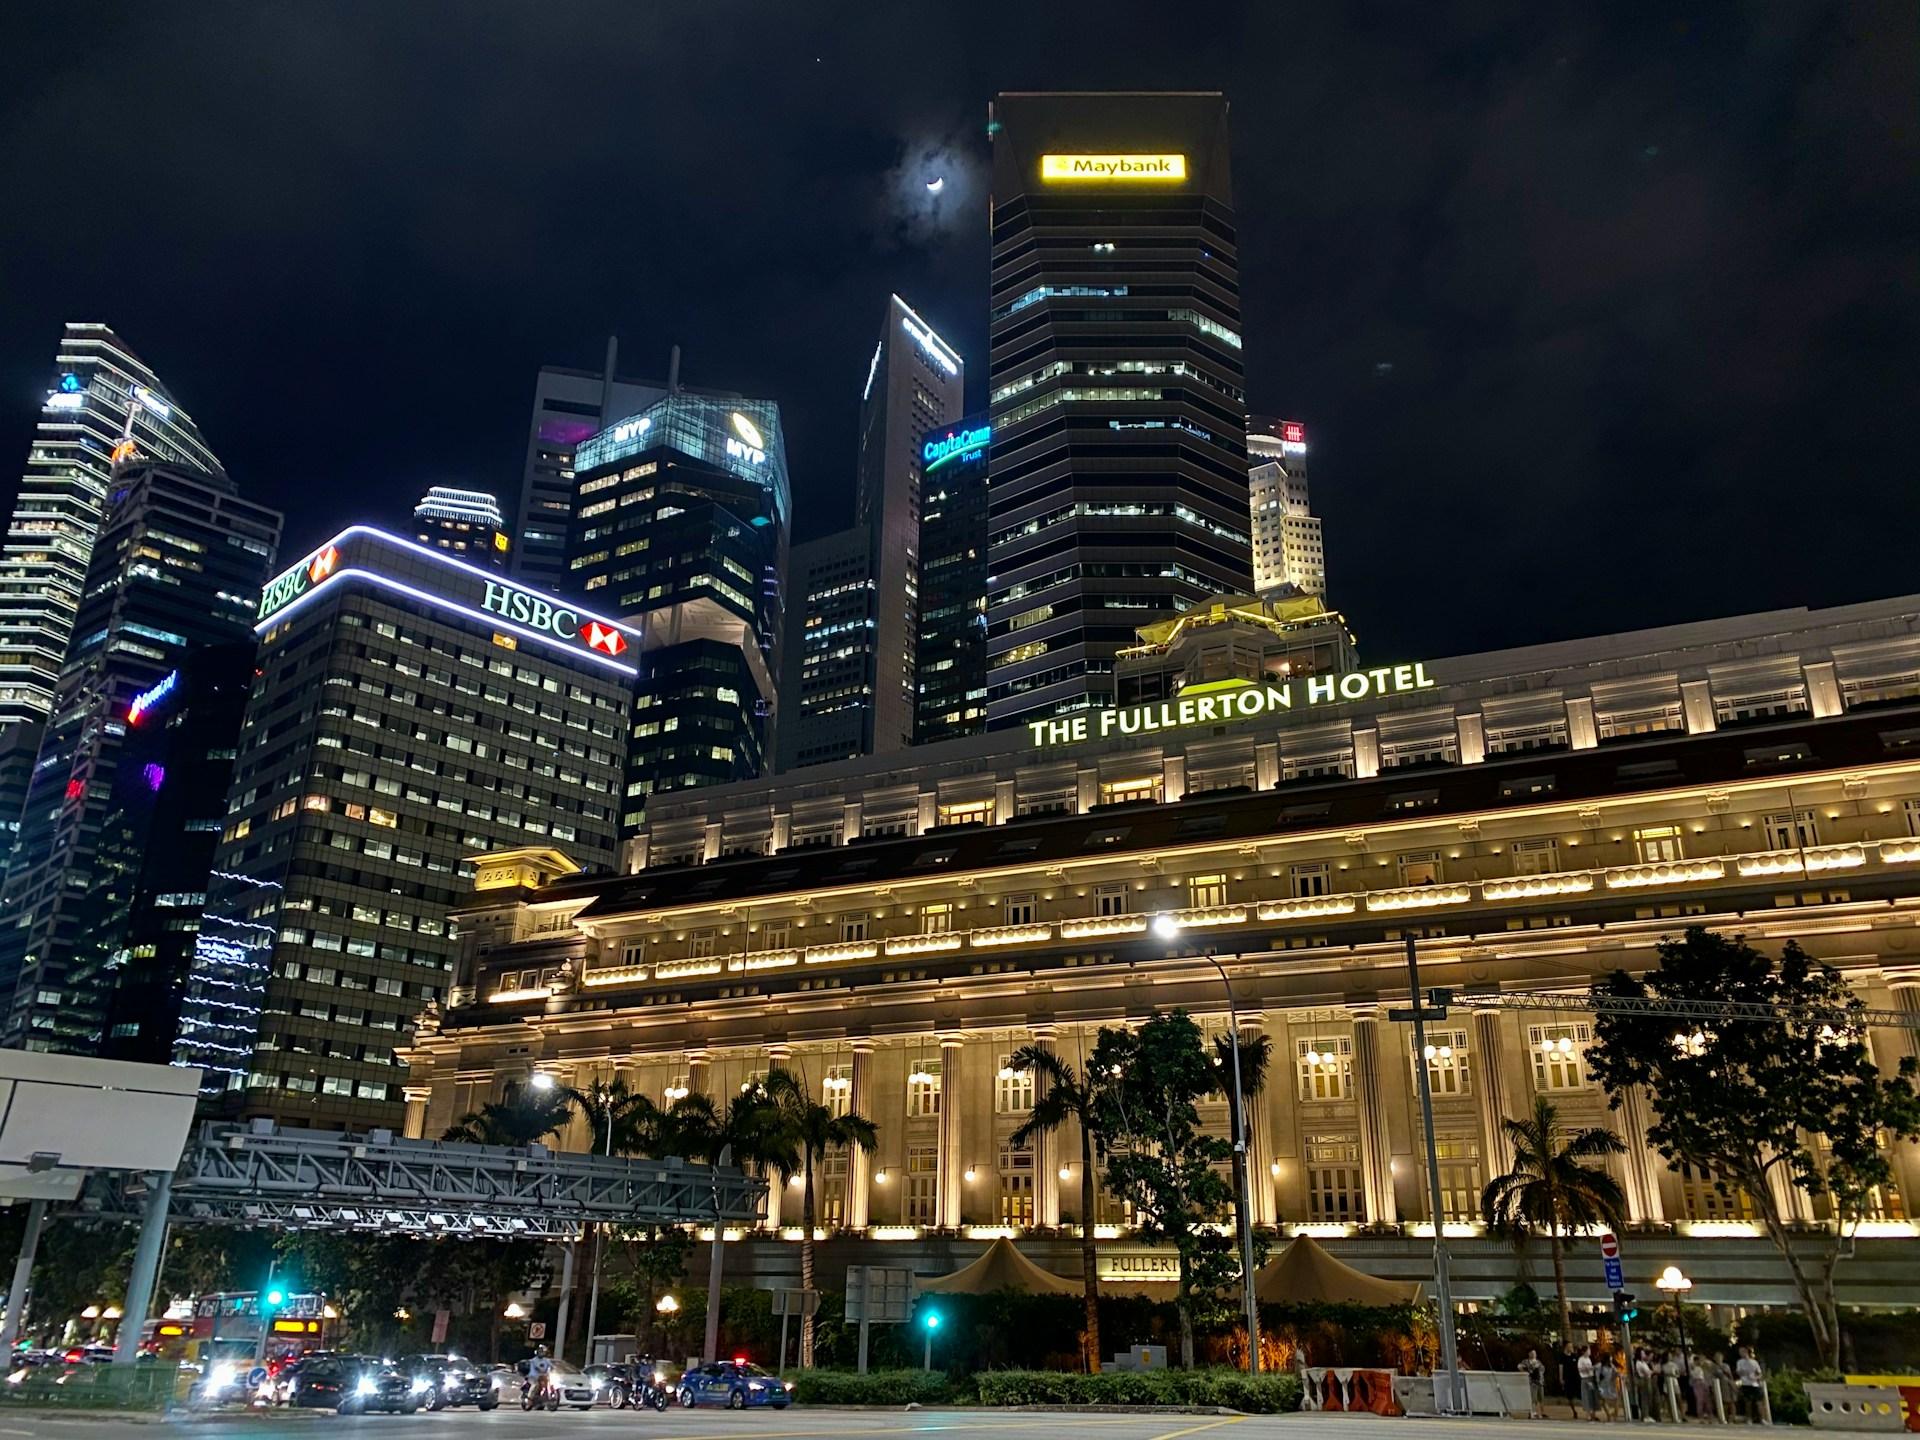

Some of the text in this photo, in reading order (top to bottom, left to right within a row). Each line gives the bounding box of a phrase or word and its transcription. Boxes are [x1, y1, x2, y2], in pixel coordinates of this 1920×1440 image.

[1073, 158, 1171, 175] Maybank
[614, 417, 651, 443] MYP
[726, 437, 766, 465] MYP
[961, 448, 982, 462] Trust
[257, 559, 311, 620] HSBC
[480, 579, 578, 640] HSBC
[1028, 662, 1435, 747] THE FULLERTON HOTEL
[1111, 1257, 1179, 1272] FULLERT
